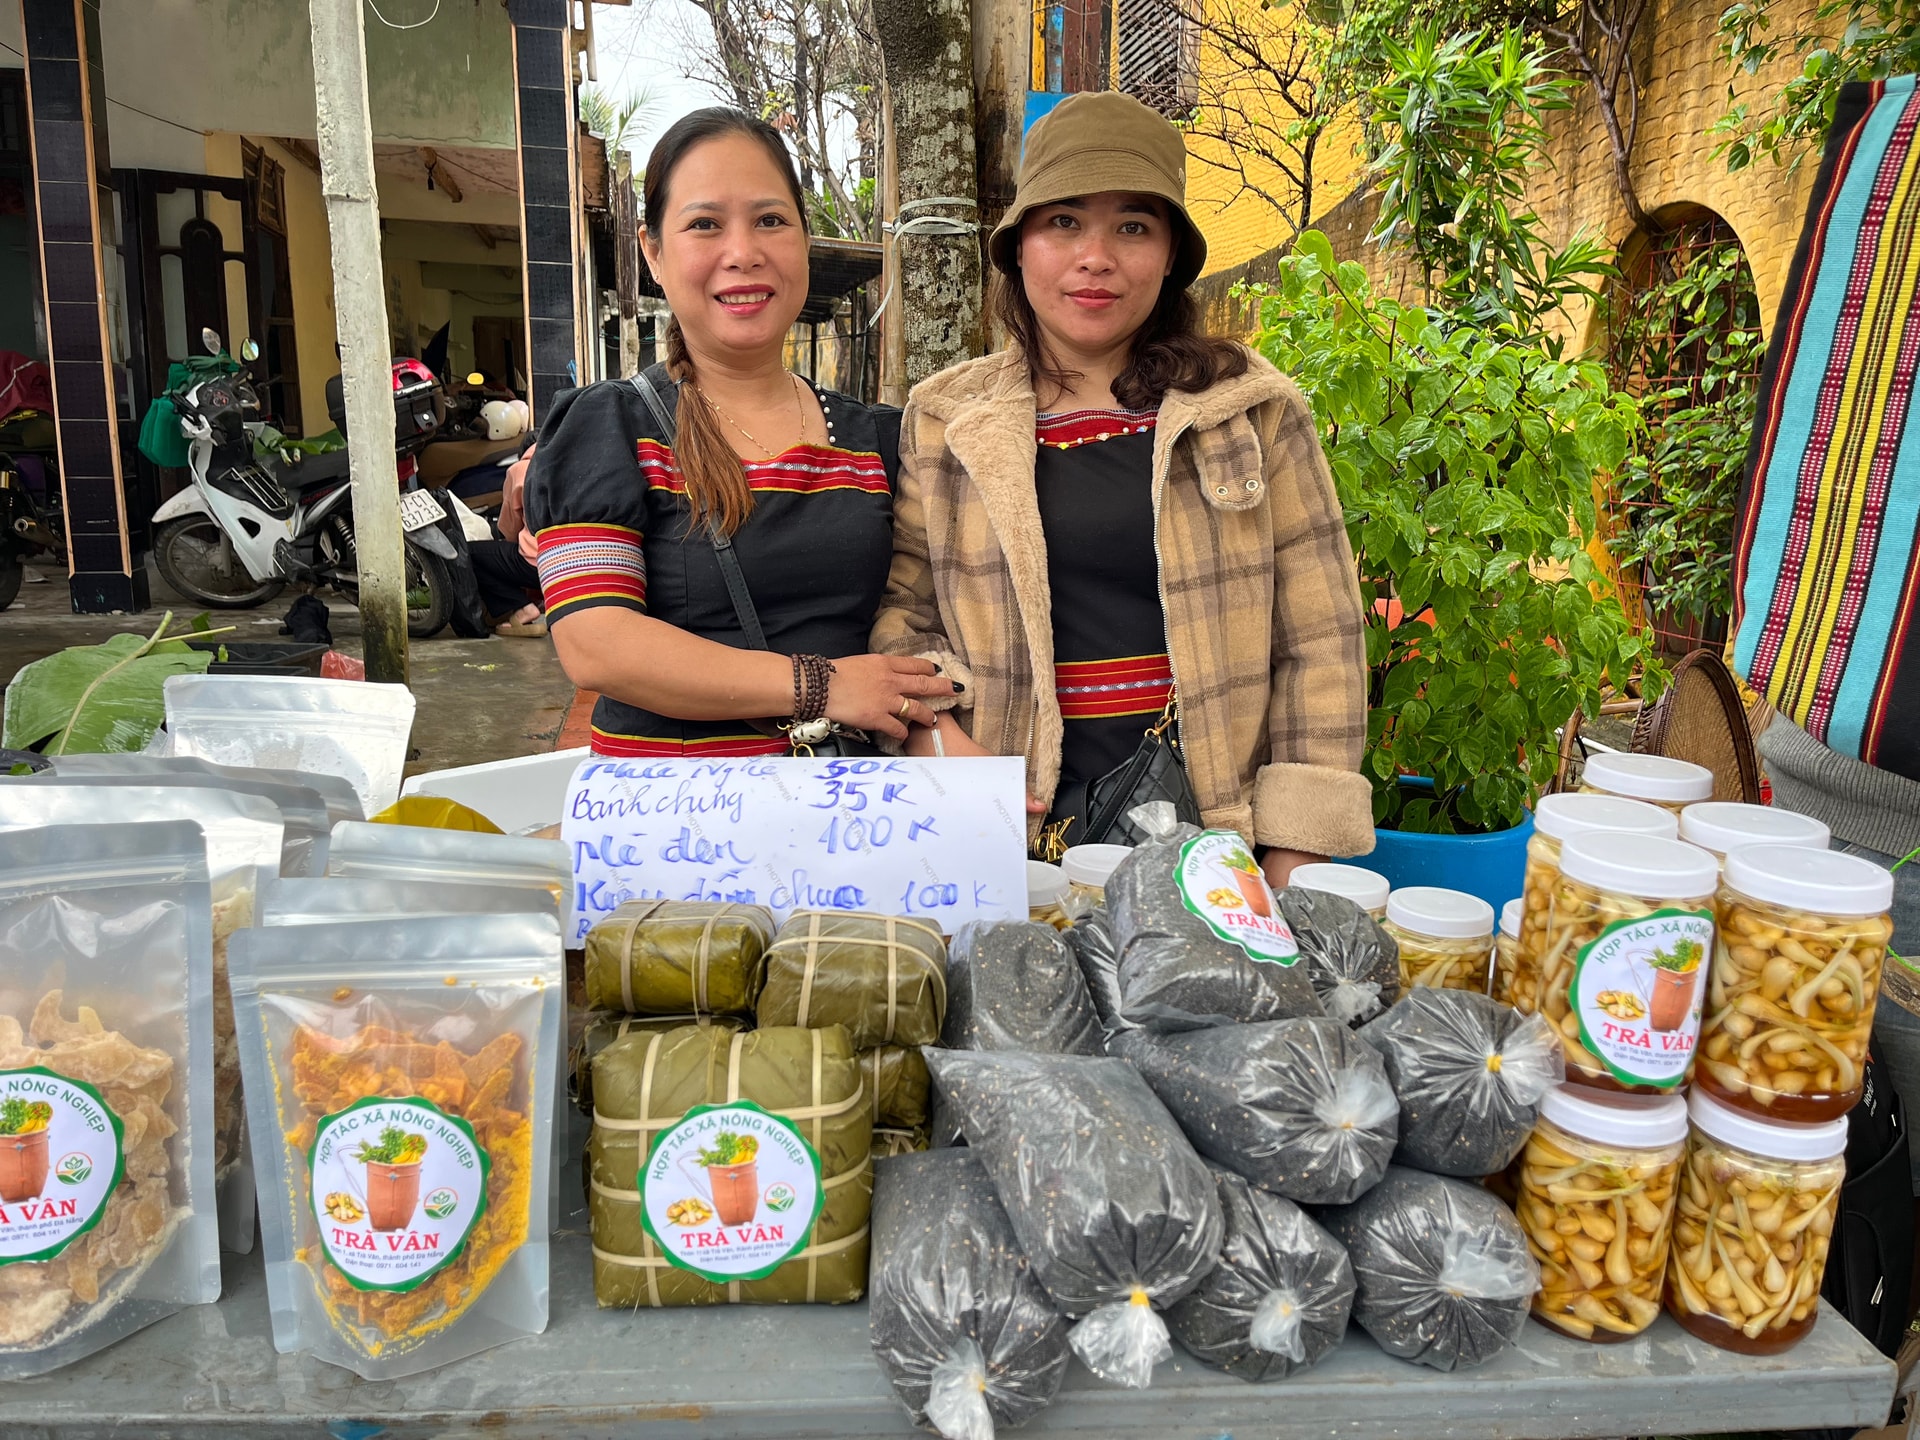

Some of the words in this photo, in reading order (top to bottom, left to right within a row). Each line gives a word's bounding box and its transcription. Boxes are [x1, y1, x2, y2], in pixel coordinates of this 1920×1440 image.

[571, 784, 652, 821] Bánh
[818, 815, 893, 854] 100
[1222, 912, 1262, 929] TRÀ
[1595, 938, 1622, 964] HỢP
[1623, 925, 1656, 943] TÁC
[1661, 920, 1681, 935] XÃ
[1602, 1021, 1651, 1048] TRÀ
[8, 1077, 58, 1096] NÔNG
[60, 1089, 106, 1134] NGHIỆP
[319, 1137, 332, 1165] HỢP
[331, 1118, 360, 1141] TÁC
[363, 1108, 386, 1125] XÃ
[390, 1108, 435, 1130] NÔNG
[436, 1125, 475, 1170] NGHIỆP
[652, 1150, 671, 1180] HỢP
[669, 1127, 695, 1152] TÁC
[698, 1115, 717, 1133] XÃ
[720, 1113, 763, 1130] NÔNG
[764, 1123, 805, 1166] NGHIỆP
[19, 1197, 77, 1221] VÂN
[331, 1228, 377, 1251] TRÀ
[386, 1230, 441, 1251] VÂN
[681, 1226, 730, 1248] TRÀ
[736, 1223, 784, 1243] VÂN
